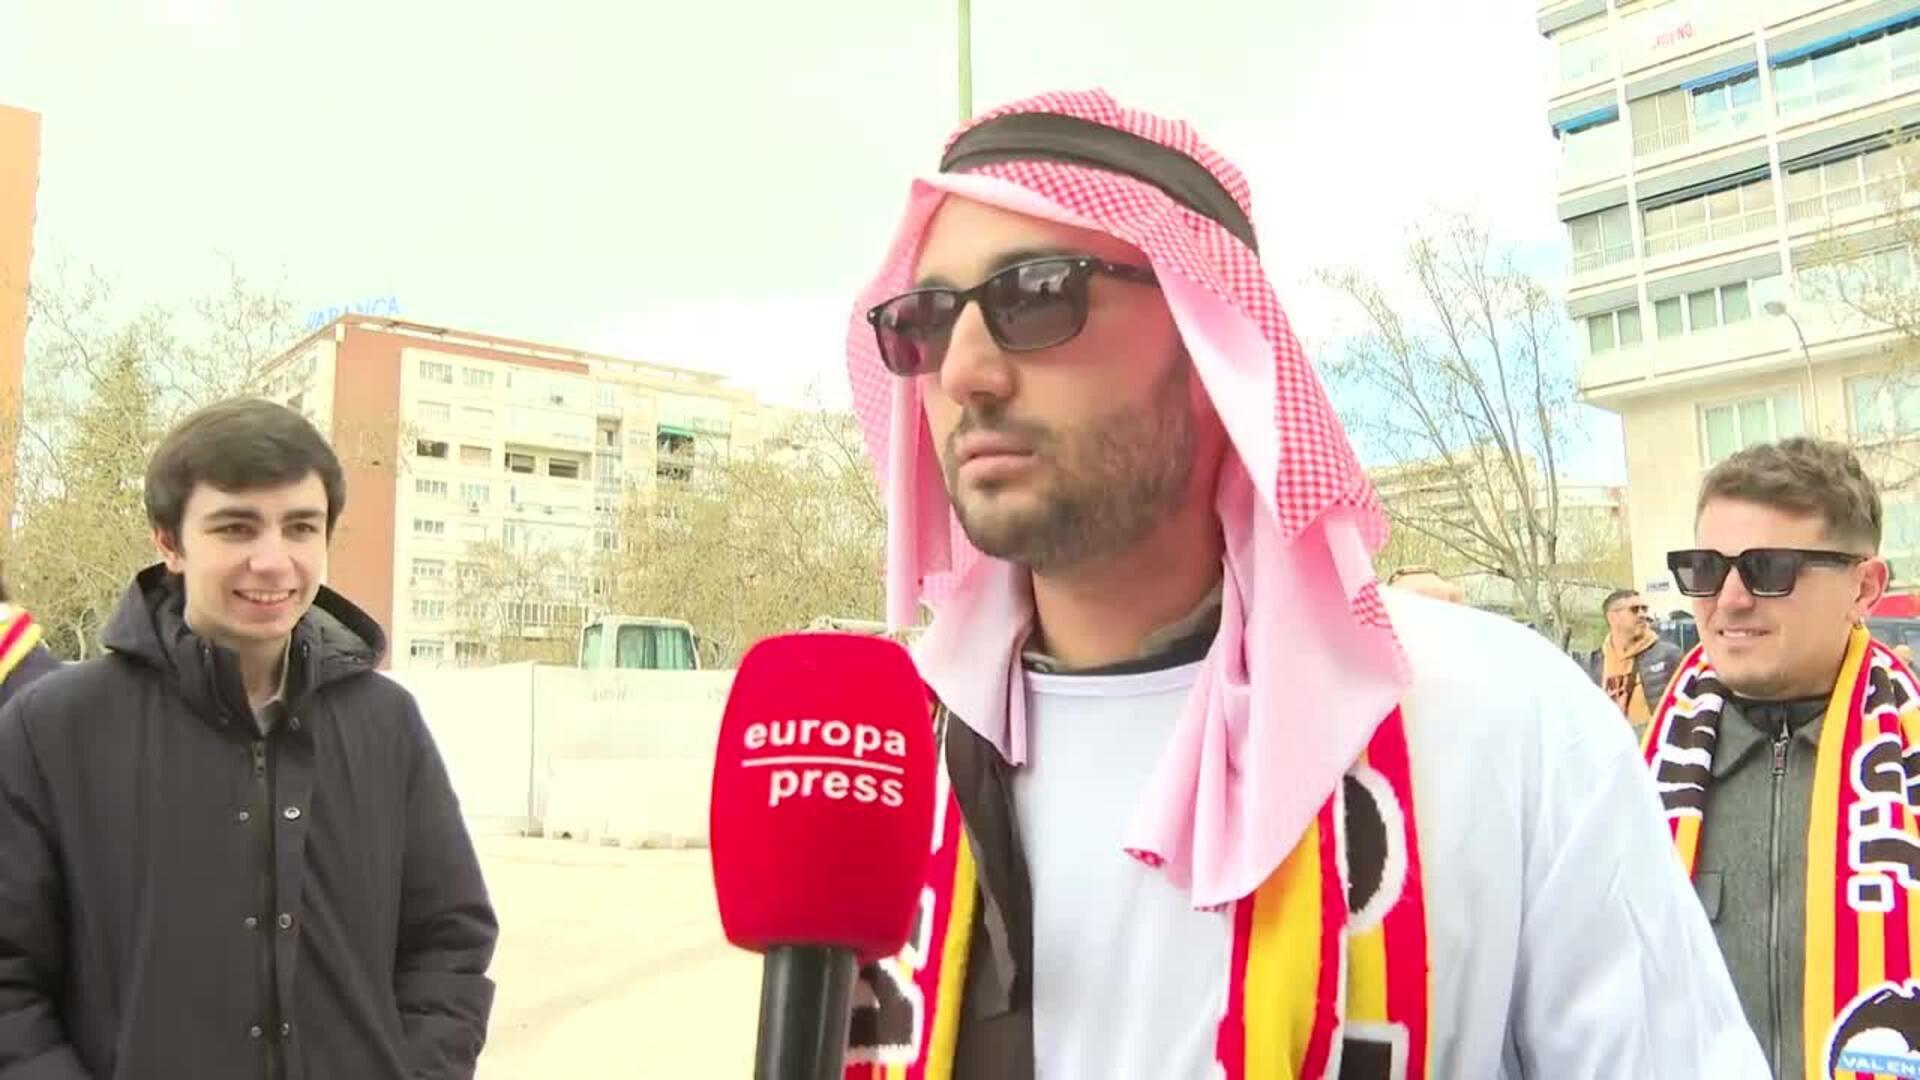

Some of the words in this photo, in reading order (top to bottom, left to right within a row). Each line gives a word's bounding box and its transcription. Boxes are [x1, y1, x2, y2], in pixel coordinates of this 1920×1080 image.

[743, 719, 907, 758] europa
[768, 768, 905, 808] press
[1841, 1055, 1920, 1076] VALEN
